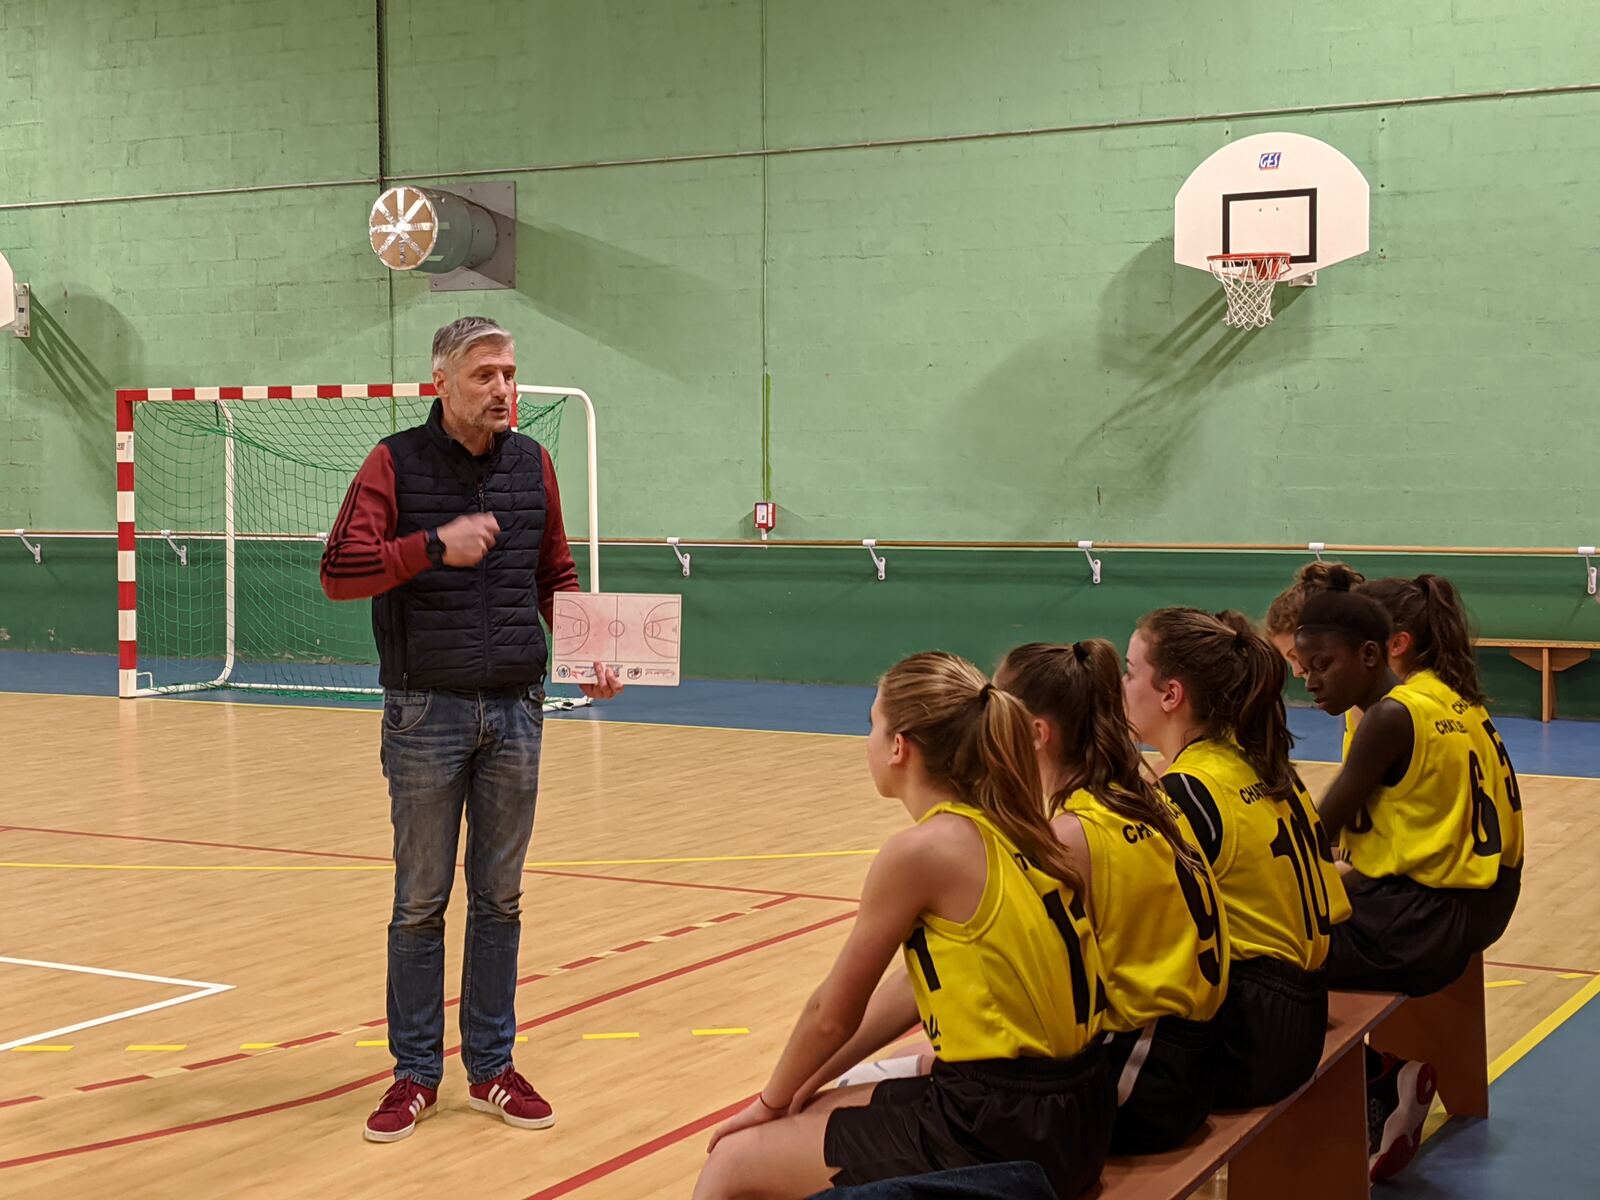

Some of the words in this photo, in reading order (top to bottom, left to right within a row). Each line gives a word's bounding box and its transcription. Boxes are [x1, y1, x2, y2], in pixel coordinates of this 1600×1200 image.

[1260, 153, 1280, 167] GES
[1469, 749, 1502, 857] 6
[1174, 853, 1221, 987] 9
[1270, 800, 1331, 941] 10
